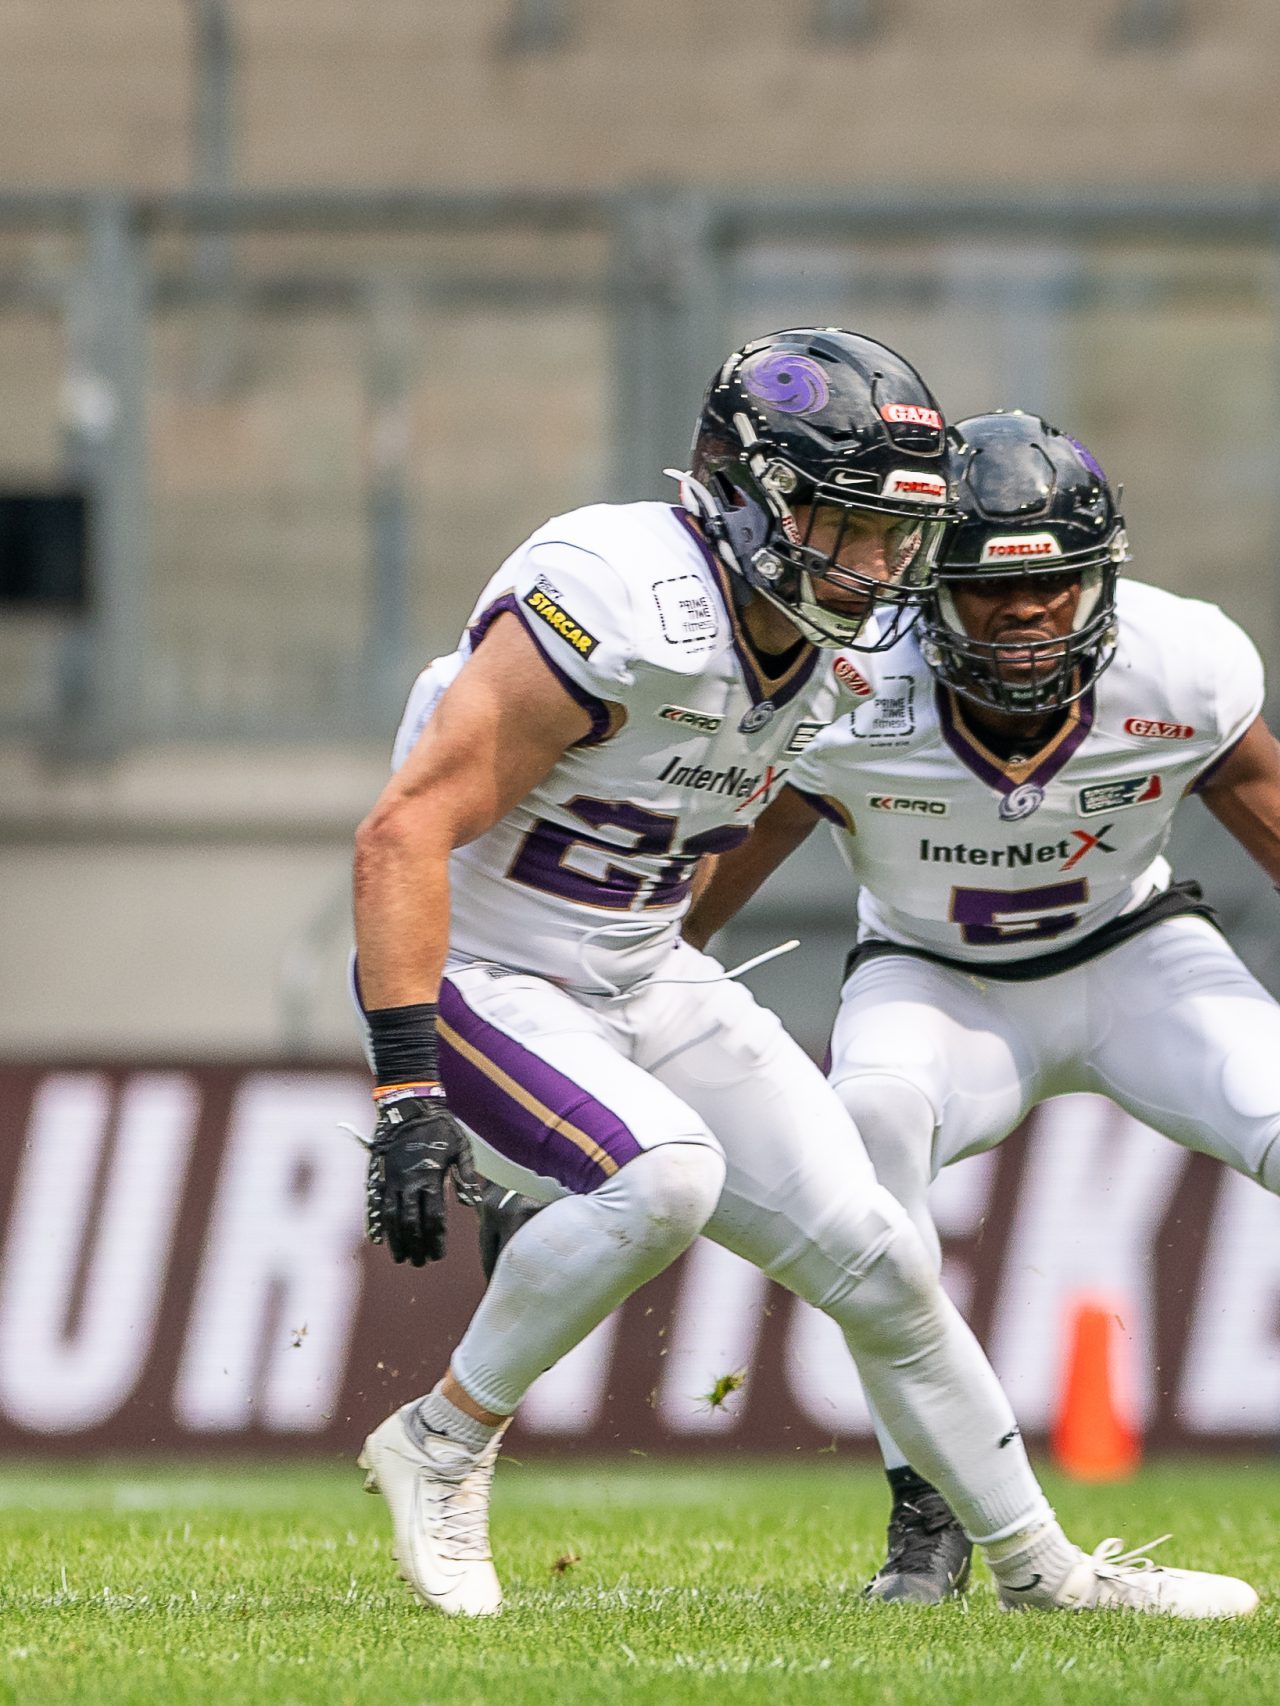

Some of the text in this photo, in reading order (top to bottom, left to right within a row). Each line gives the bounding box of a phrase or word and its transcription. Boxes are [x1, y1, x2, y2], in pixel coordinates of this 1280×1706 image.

[887, 404, 941, 428] GAZI
[528, 592, 593, 653] STARCAR
[1129, 720, 1188, 739] GAZI
[919, 823, 1118, 872] InterNetX
